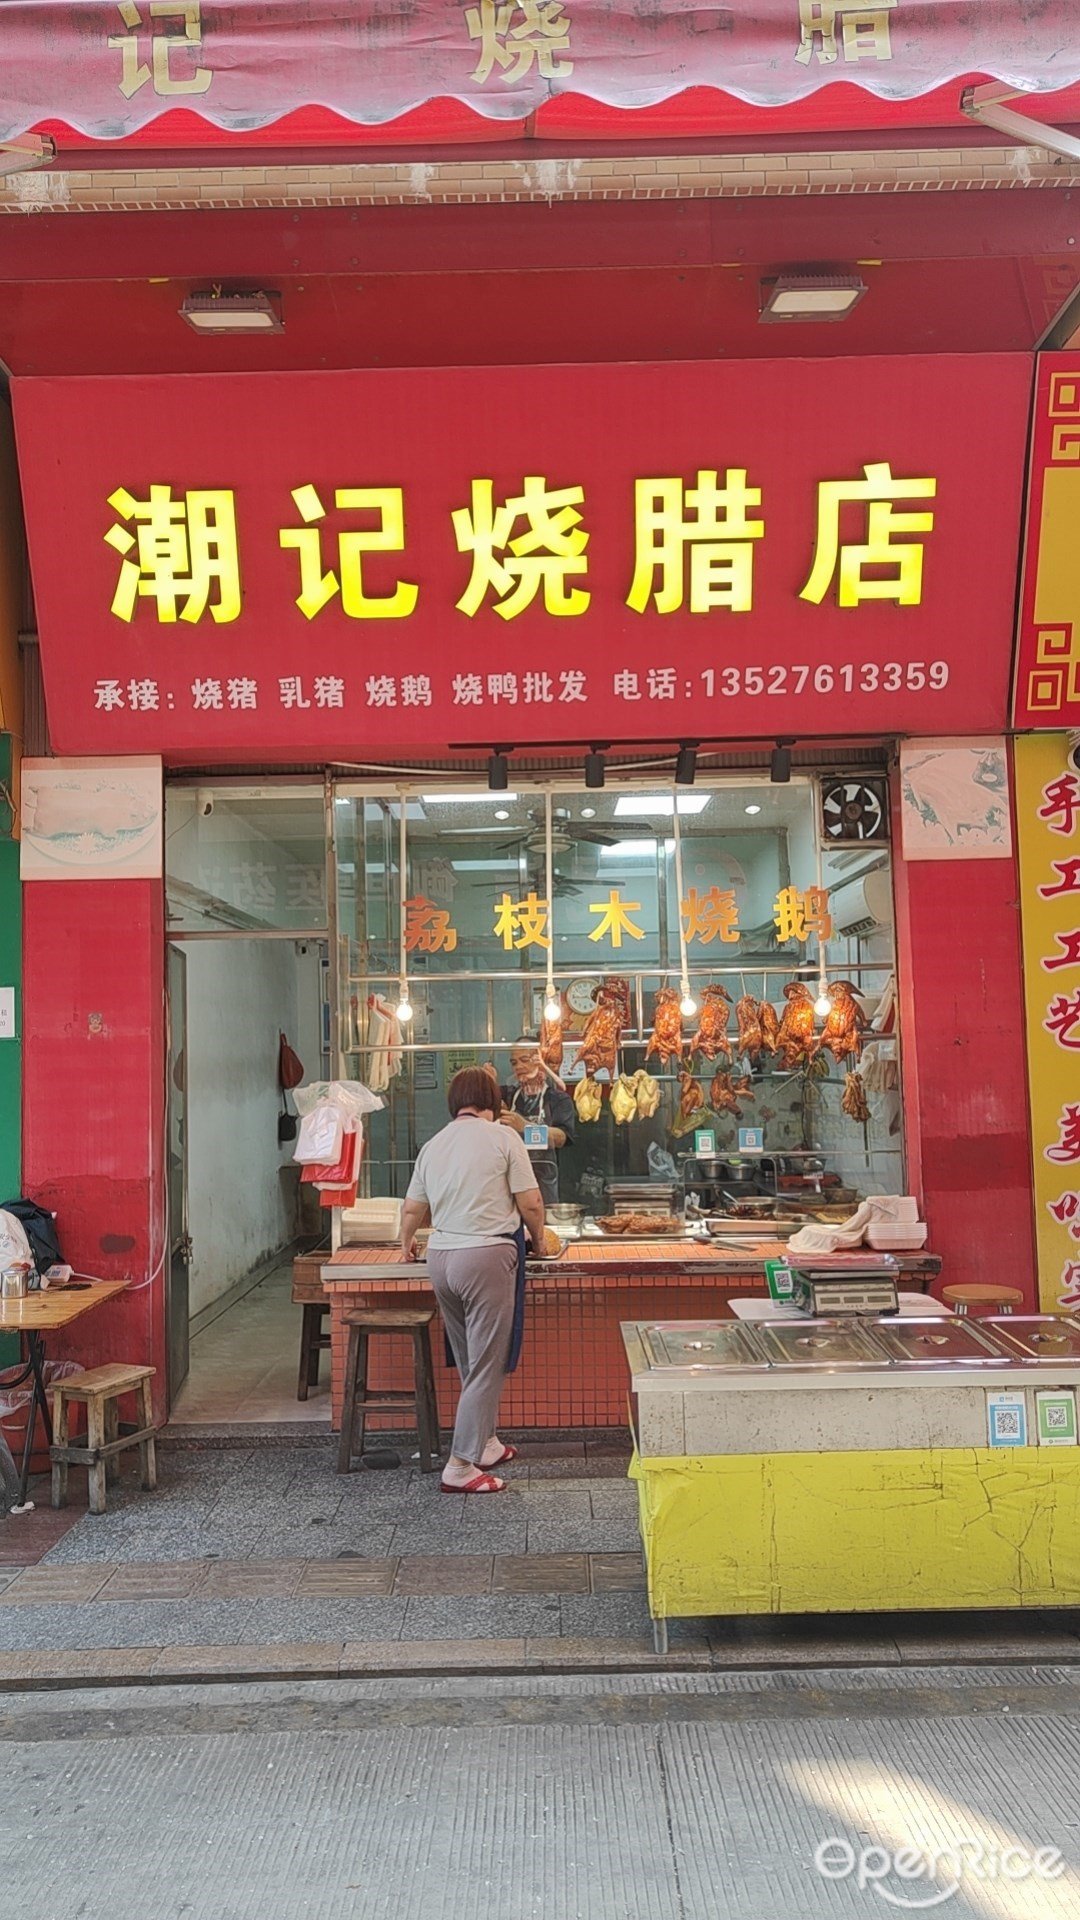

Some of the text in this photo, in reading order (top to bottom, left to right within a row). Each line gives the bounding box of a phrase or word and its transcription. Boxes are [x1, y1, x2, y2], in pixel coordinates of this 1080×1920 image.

[104, 462, 937, 624] 潮记烧腊店
[190, 677, 258, 710] 烧猪
[278, 675, 345, 709] 乳猪
[365, 674, 432, 707] 烧鹅
[452, 670, 589, 706] 烧鸭批发
[402, 885, 834, 953] 荔枝木烧鹅
